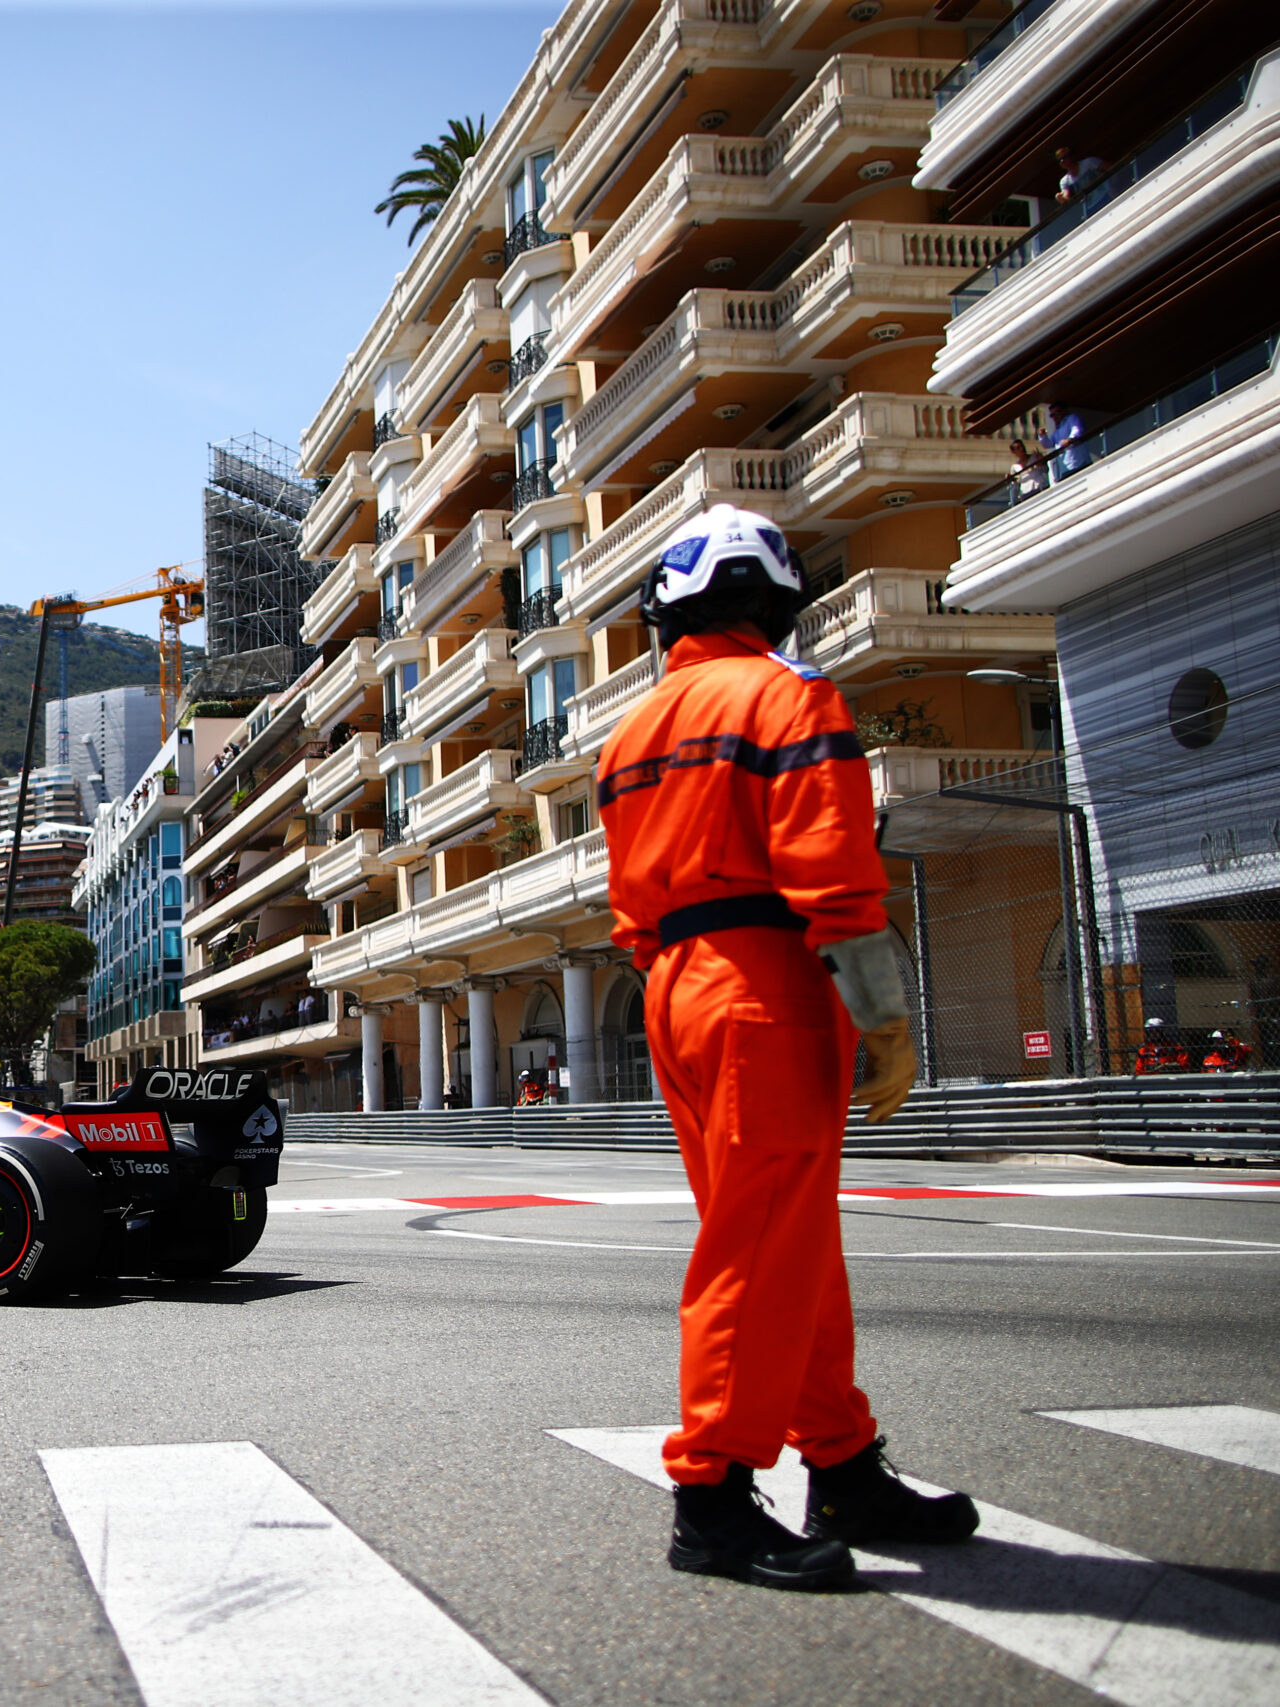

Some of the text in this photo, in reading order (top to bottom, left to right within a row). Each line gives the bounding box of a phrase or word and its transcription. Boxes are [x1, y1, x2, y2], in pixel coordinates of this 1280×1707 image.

[724, 532, 743, 543] 34
[145, 1071, 253, 1100] ORACLE
[77, 1123, 140, 1142] Mobil
[125, 1160, 170, 1175] Tezos
